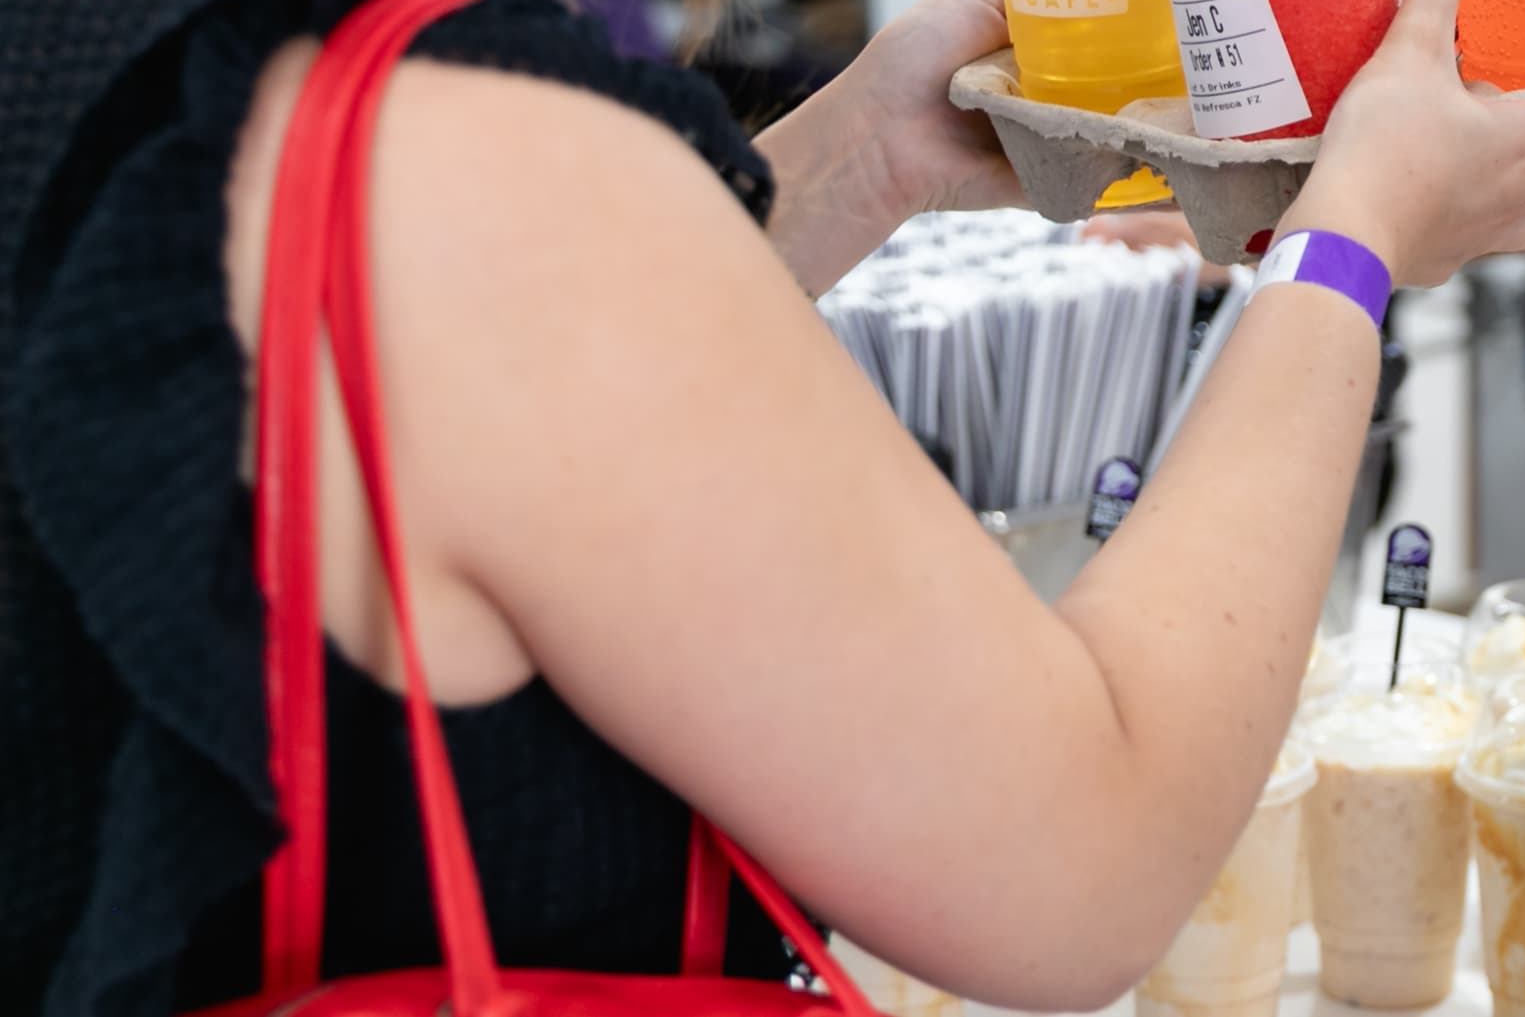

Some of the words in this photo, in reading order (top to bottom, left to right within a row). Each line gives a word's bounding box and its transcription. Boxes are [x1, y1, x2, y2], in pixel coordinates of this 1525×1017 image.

[1185, 7, 1208, 37] Jen
[1209, 5, 1224, 34] C
[1225, 43, 1243, 66] 51
[1208, 80, 1242, 92] Drinks
